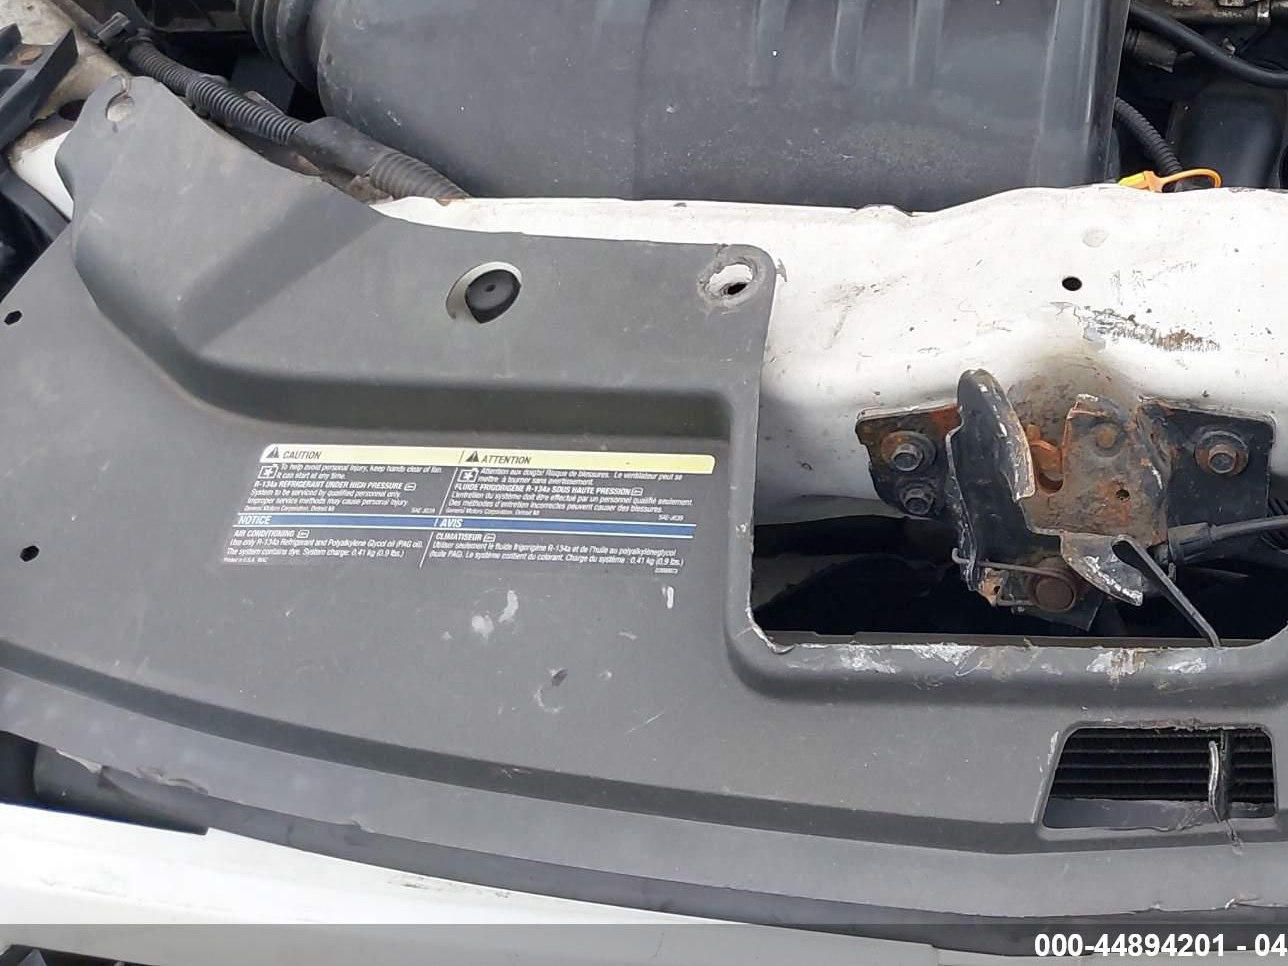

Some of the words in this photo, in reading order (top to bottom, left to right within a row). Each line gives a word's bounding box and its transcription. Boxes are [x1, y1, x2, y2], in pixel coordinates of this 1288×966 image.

[283, 451, 322, 460] CAUTION
[481, 455, 532, 465] ATTENTION
[289, 464, 303, 472] help
[624, 472, 658, 480] ventilateur
[658, 474, 674, 482] peut
[325, 481, 349, 489] UNDER
[367, 482, 403, 490] PRESSURE
[454, 483, 479, 491] FLUIDE
[526, 485, 551, 493] R-134a
[551, 486, 570, 494] SOUS
[572, 486, 595, 495] HAUTE
[596, 488, 632, 496] PRESSION
[251, 489, 274, 497] System
[319, 490, 327, 498] by
[327, 490, 355, 498] qualified
[327, 499, 340, 507] may
[361, 499, 390, 507] personal
[448, 499, 461, 507] Des
[617, 504, 630, 512] des
[577, 496, 589, 504] par
[599, 496, 632, 505] personnel
[238, 516, 272, 525] NOTICE
[440, 518, 463, 528] AVIS
[436, 532, 482, 541] CLIMATISEUR
[242, 539, 255, 548] only
[280, 539, 315, 548] Refrigerant
[367, 540, 387, 549] Glycol
[387, 540, 396, 548] oil
[455, 542, 488, 550] seulement
[548, 544, 571, 552] R-134a
[303, 548, 326, 556] System
[367, 550, 376, 558] kg
[501, 552, 527, 560] contient
[565, 554, 588, 564] Charge
[646, 558, 655, 566] kg
